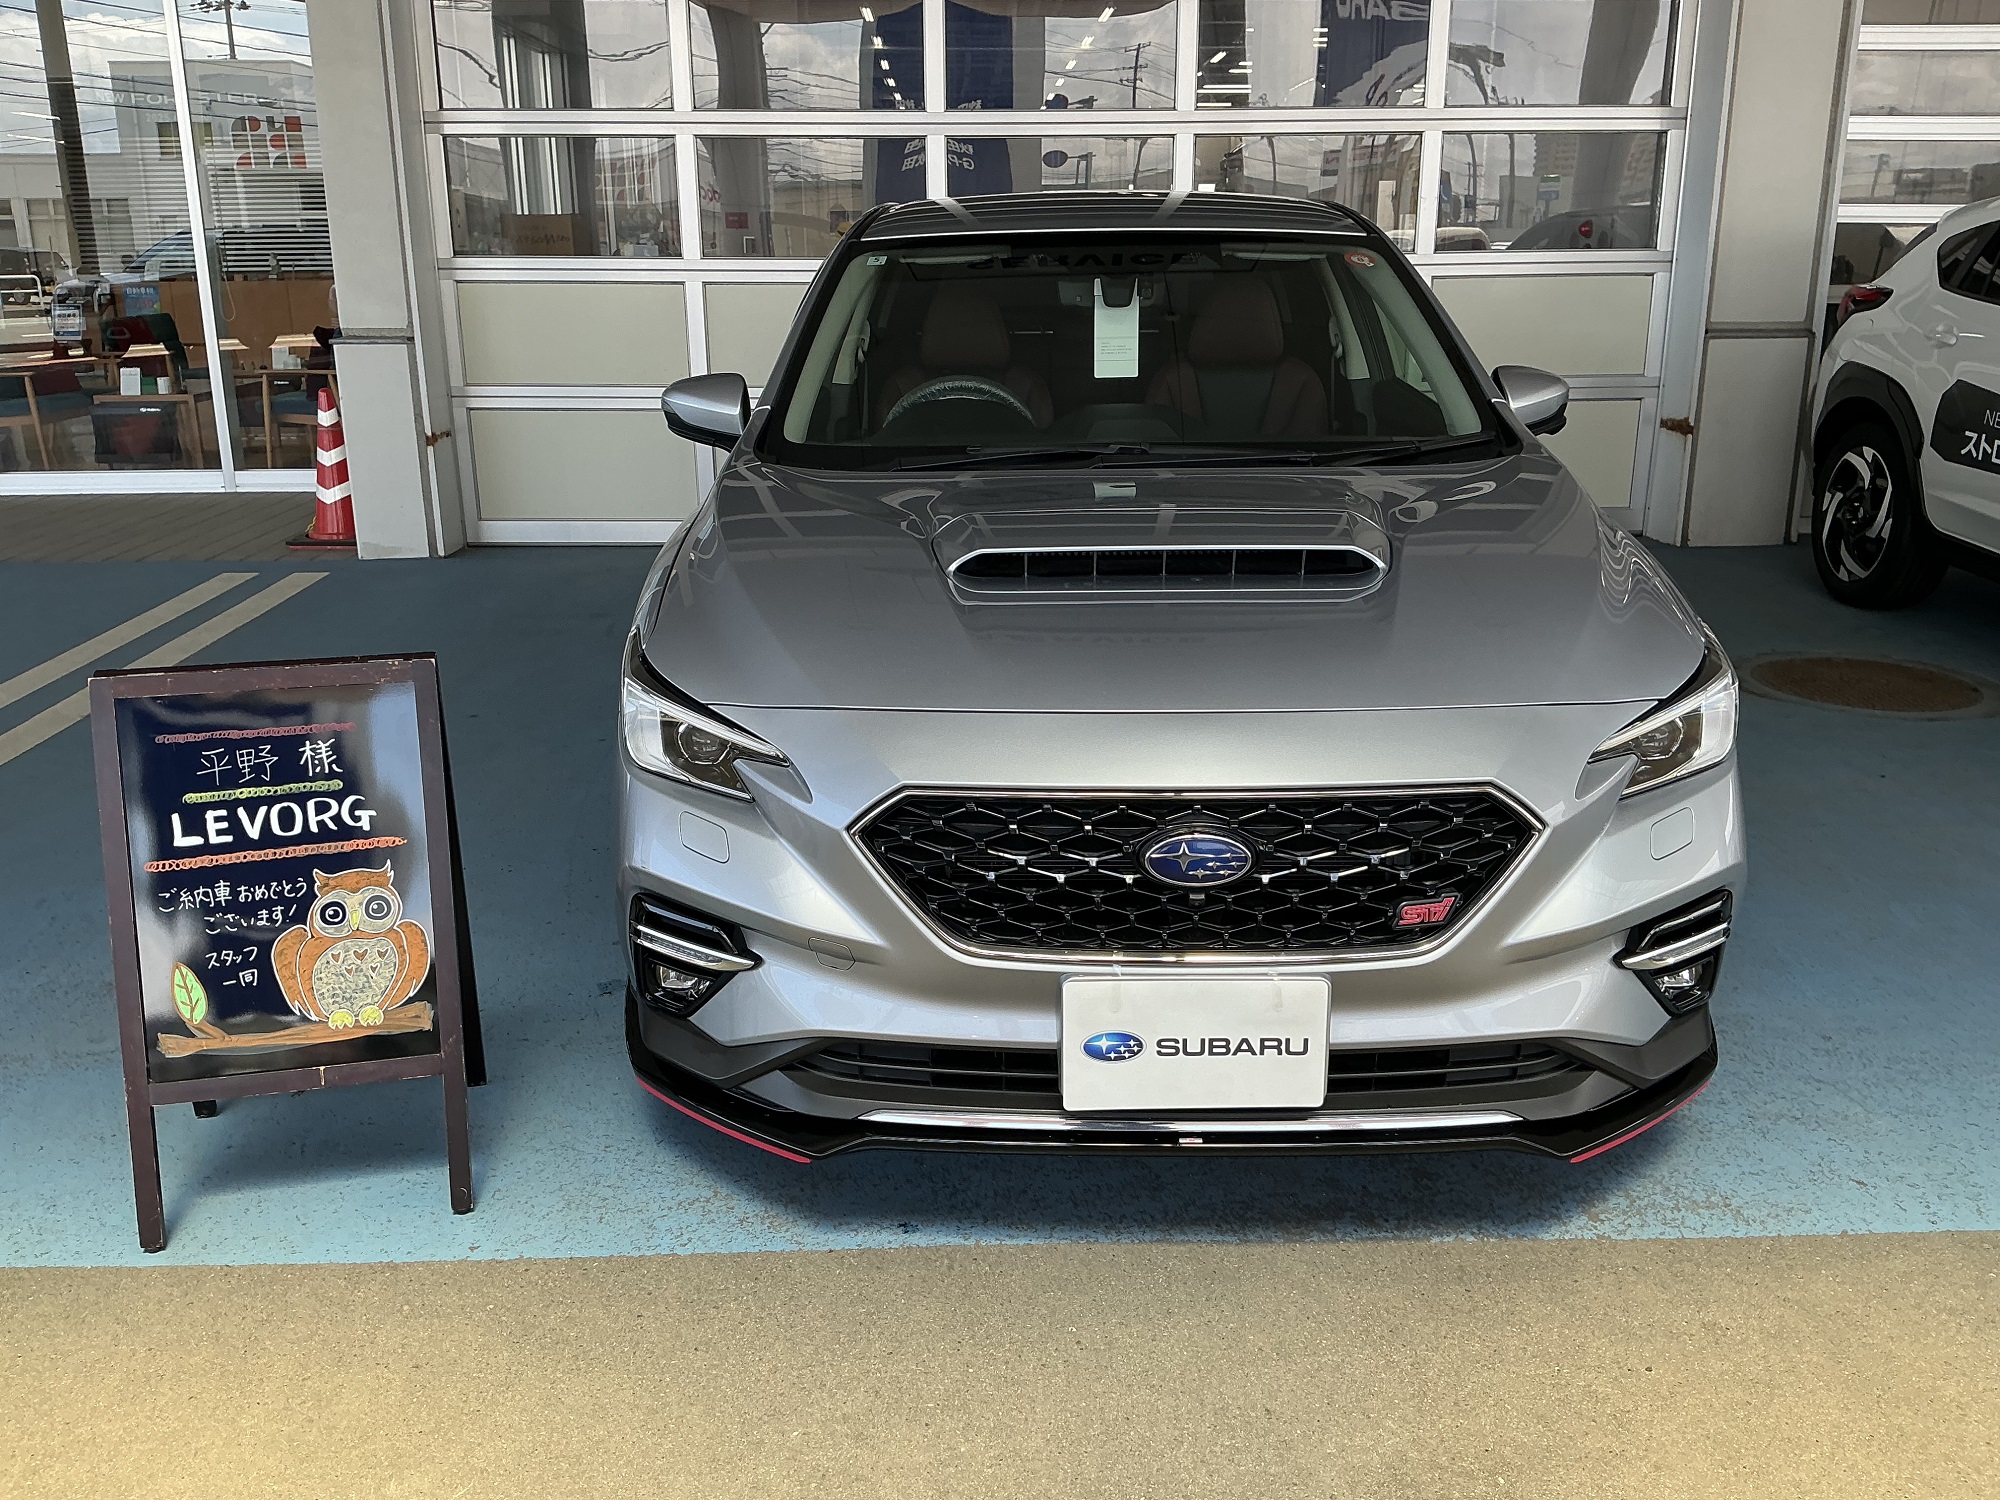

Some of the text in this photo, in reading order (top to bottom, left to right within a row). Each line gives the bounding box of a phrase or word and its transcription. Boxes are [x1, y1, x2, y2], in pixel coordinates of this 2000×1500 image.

[196, 738, 343, 786] 平野 様
[171, 794, 377, 847] LEVORG
[236, 877, 308, 903] おめでとう
[205, 946, 258, 970] スタッフ
[222, 968, 258, 987] 一同
[1155, 1037, 1309, 1057] SUBARU
